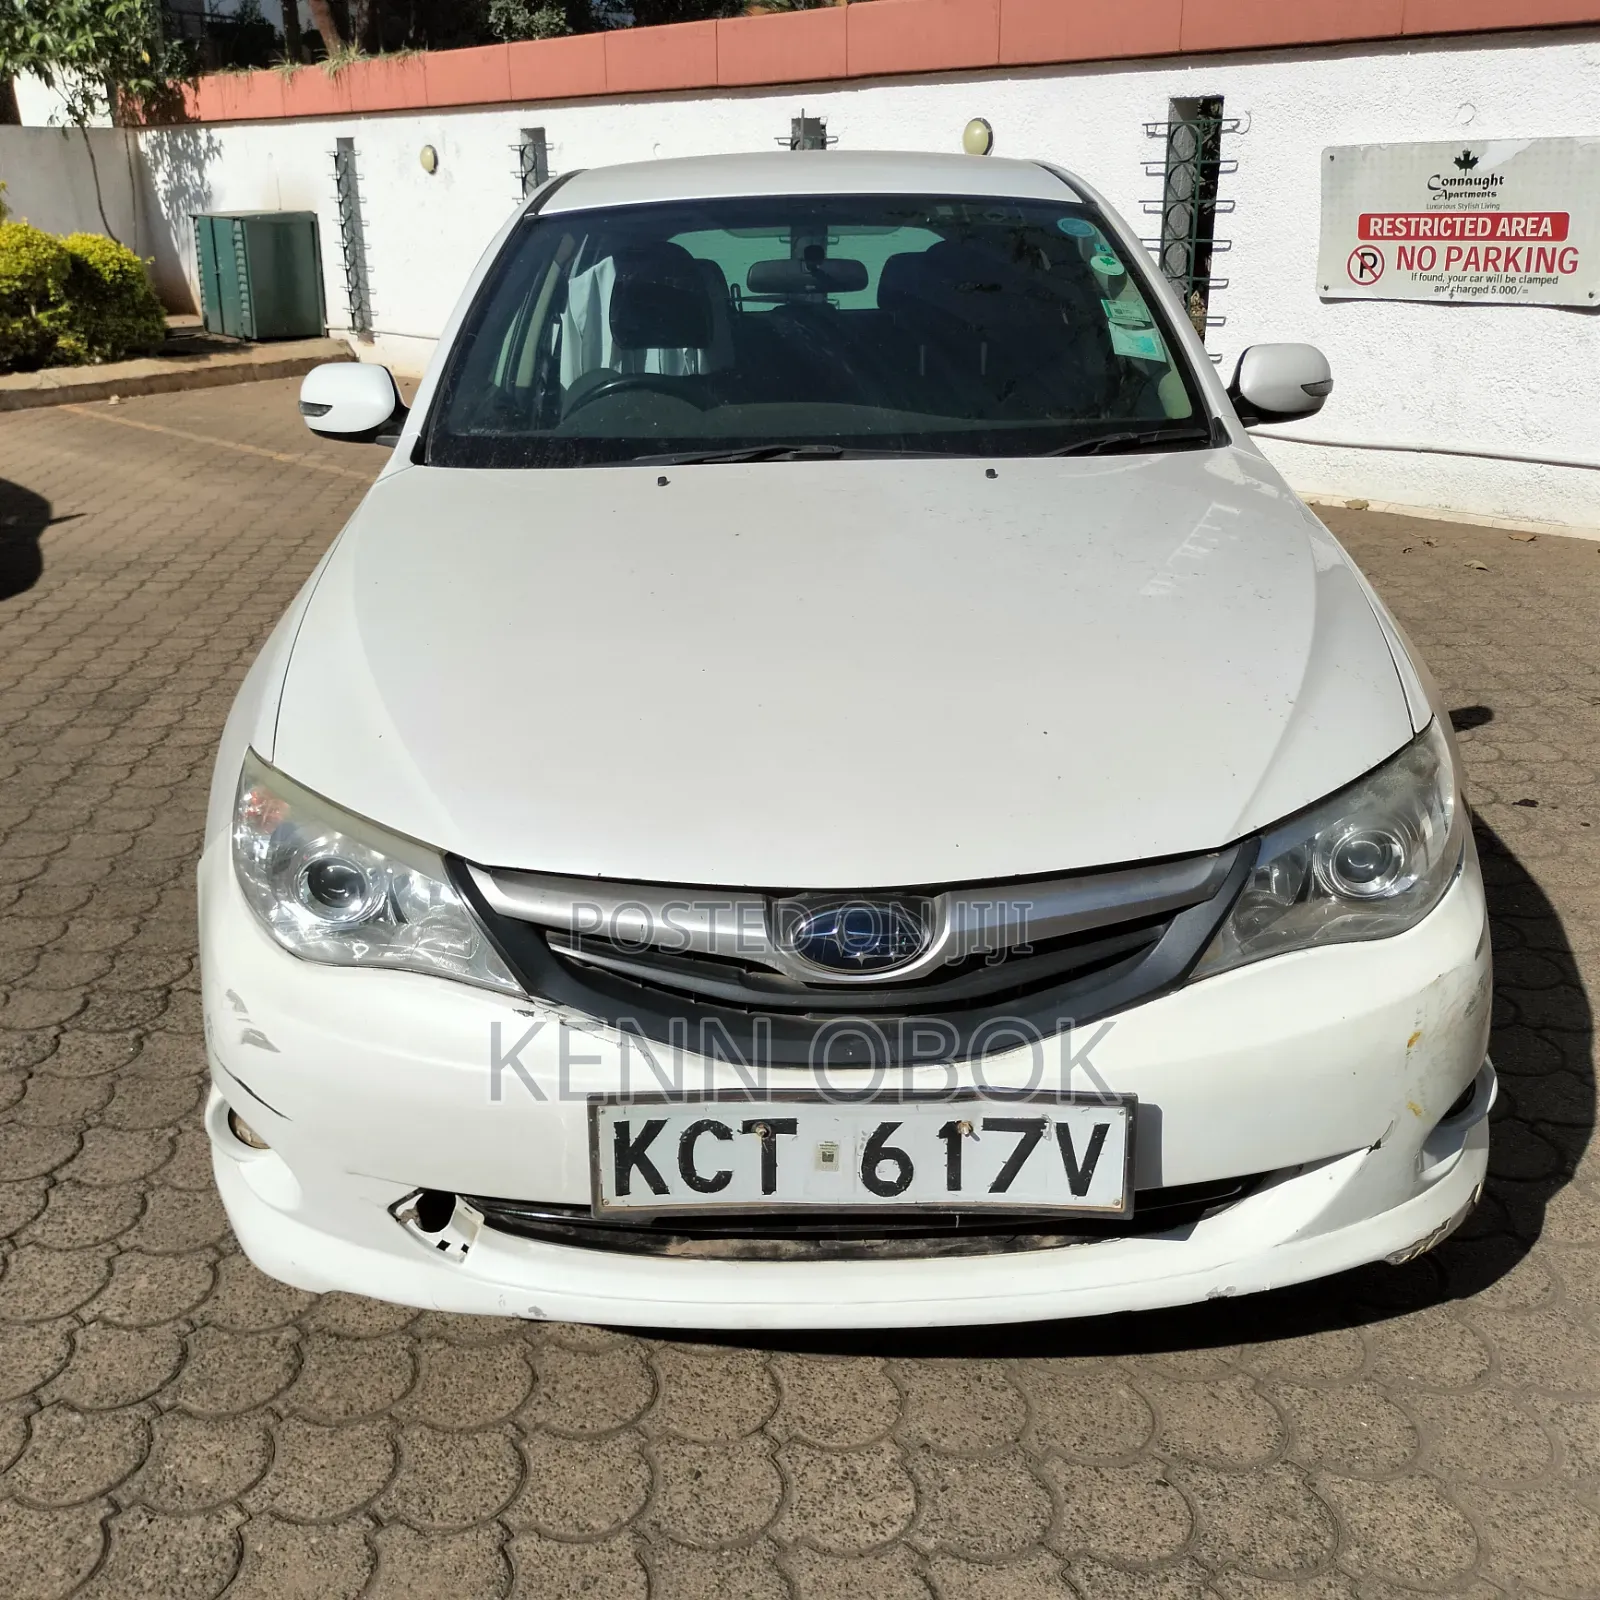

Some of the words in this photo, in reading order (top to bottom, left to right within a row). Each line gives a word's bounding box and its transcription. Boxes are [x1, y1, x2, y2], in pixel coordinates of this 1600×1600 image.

[1427, 173, 1504, 190] Connaught
[1432, 189, 1497, 201] Apartments
[1458, 203, 1480, 211] Stylish
[1369, 217, 1492, 237] RESTRICTED
[1496, 217, 1553, 237] AREA
[1396, 245, 1437, 271] NO
[1444, 246, 1579, 274] PARKING
[1411, 272, 1418, 281] If
[1419, 272, 1445, 283] found,
[1447, 275, 1468, 284] your
[1469, 275, 1484, 283] car
[1485, 274, 1502, 283] will
[1505, 274, 1517, 284] be
[1518, 275, 1559, 287] clamped
[613, 1117, 798, 1197] KCT
[859, 1117, 1111, 1198] 617V
